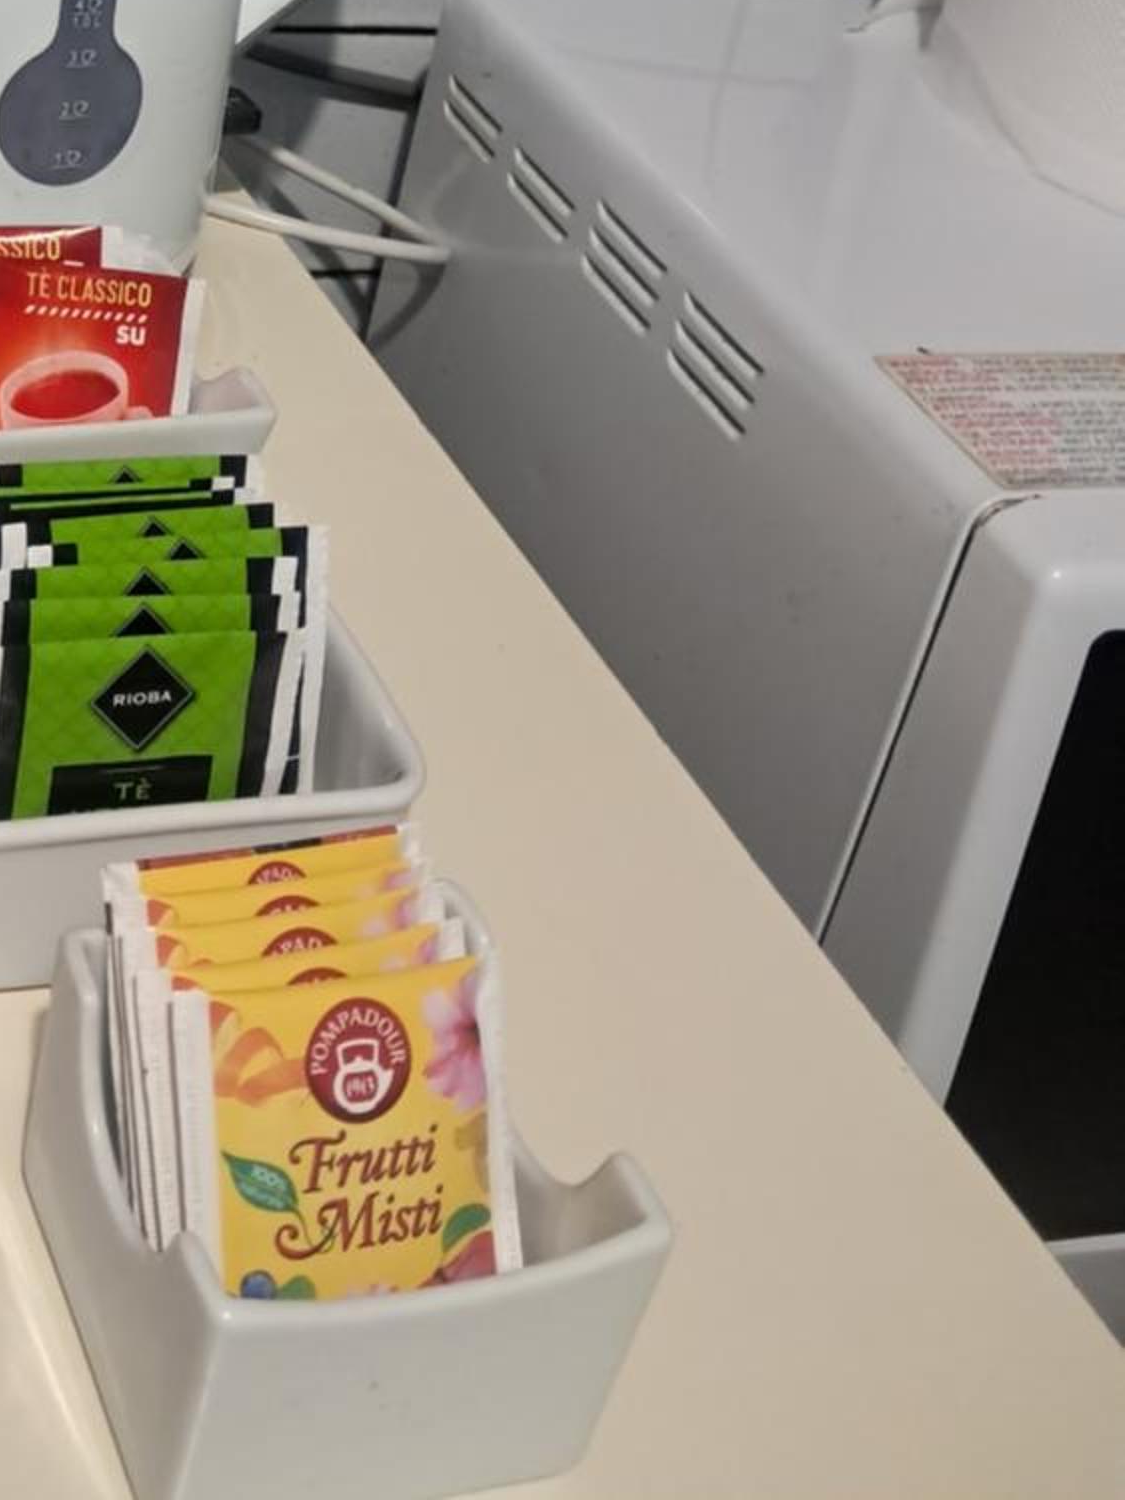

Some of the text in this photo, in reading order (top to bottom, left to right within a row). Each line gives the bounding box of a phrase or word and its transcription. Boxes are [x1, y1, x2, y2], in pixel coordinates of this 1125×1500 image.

[27, 267, 152, 308] TÈ CLASSICO
[112, 689, 172, 707] RIOBA
[113, 777, 152, 801] TÈ
[310, 1007, 408, 1076] POMPADOUR
[288, 1124, 438, 1194] Frutti
[275, 1183, 443, 1260] Misti
